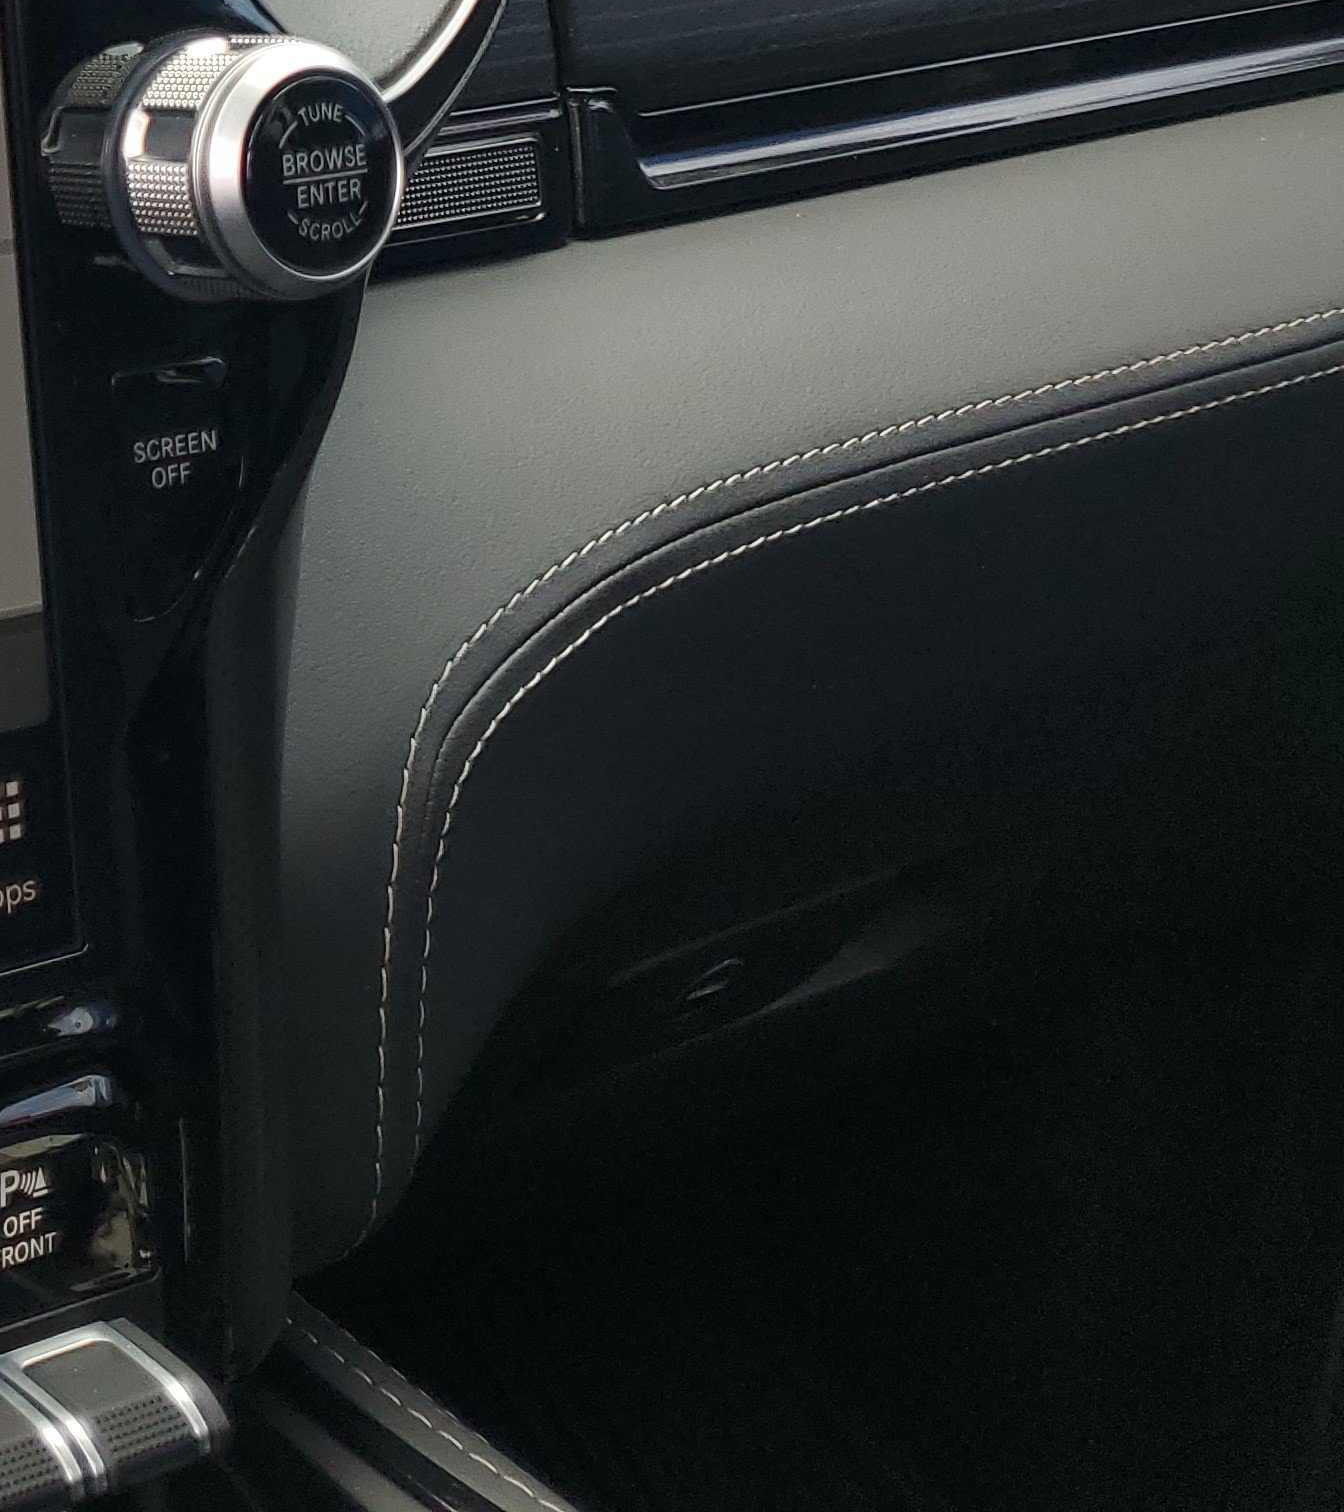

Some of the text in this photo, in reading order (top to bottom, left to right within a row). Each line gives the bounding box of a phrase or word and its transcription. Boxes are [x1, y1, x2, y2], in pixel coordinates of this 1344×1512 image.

[296, 102, 345, 125] TUNE
[283, 143, 367, 174] BROWSE
[297, 179, 361, 209] ENTER
[298, 212, 363, 241] SCROLL
[133, 429, 218, 464] SCREEN
[151, 462, 192, 488] OFF
[3, 1209, 43, 1237] OFF
